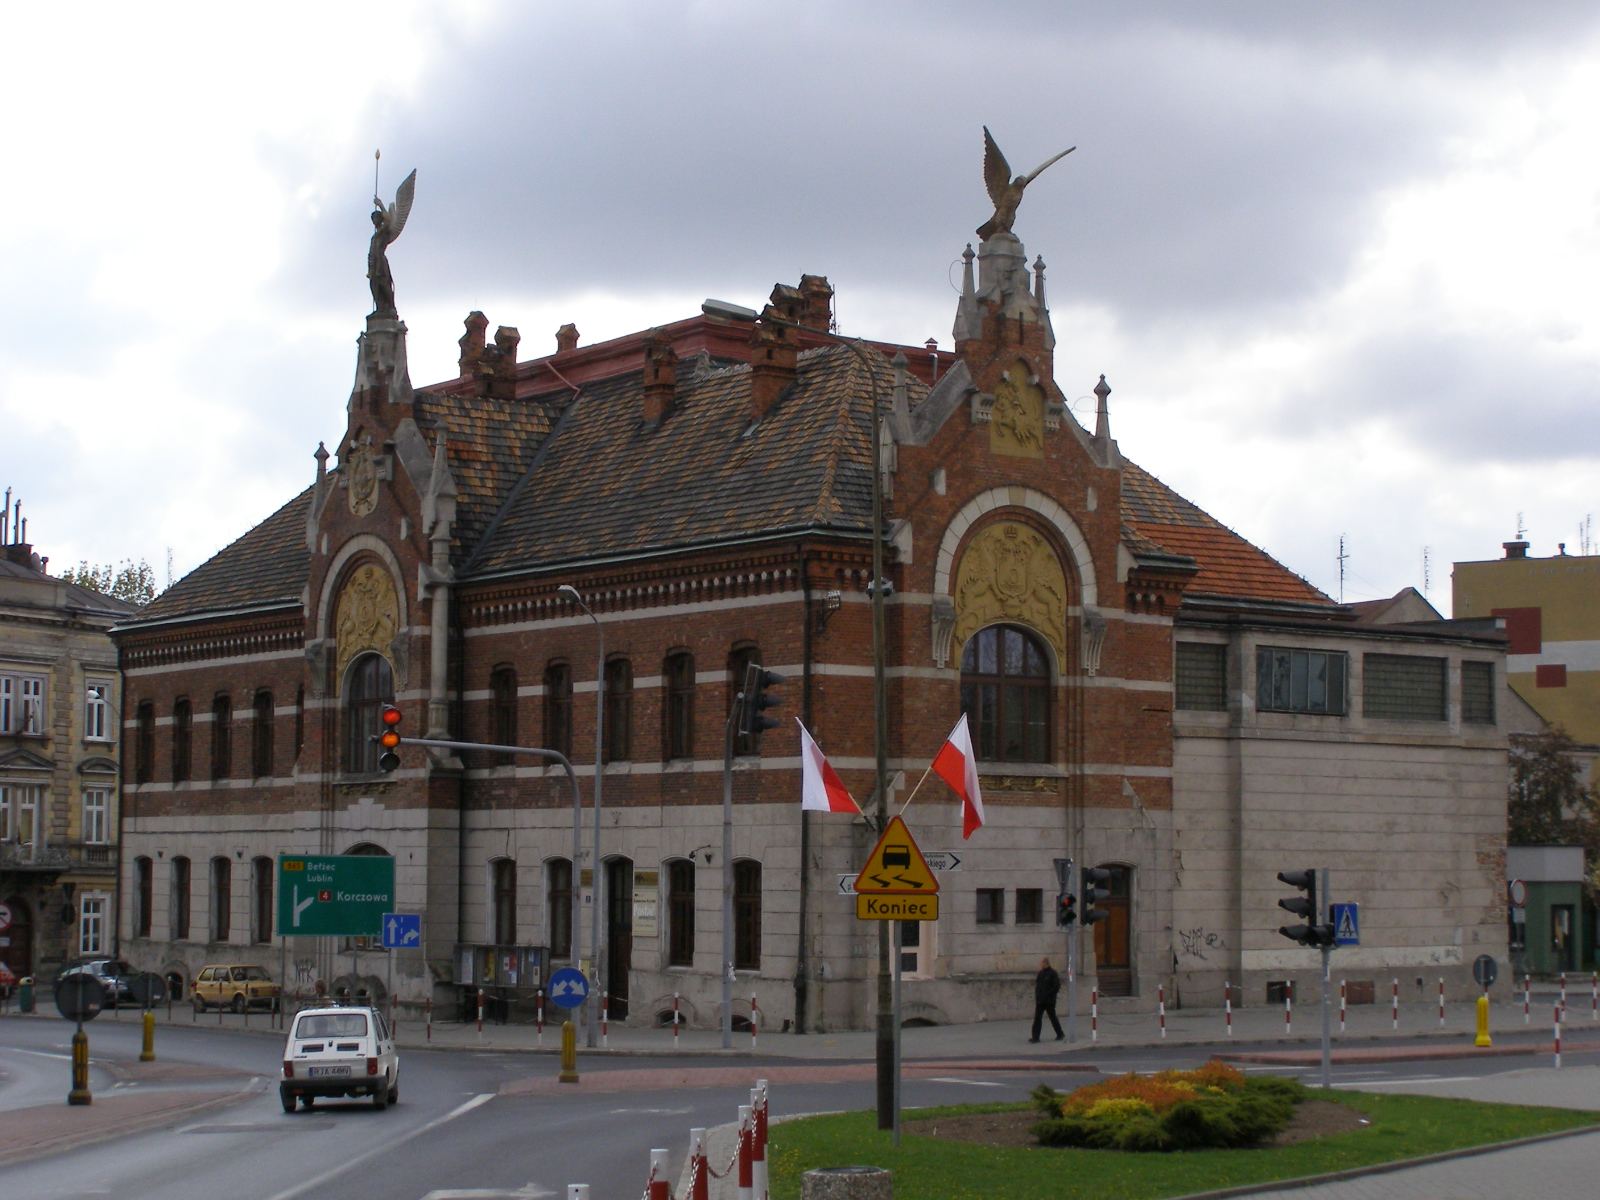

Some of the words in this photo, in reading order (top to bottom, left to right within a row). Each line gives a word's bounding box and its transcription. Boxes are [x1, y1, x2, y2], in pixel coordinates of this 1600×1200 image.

[307, 874, 333, 882] Lublin
[322, 892, 328, 900] 4
[337, 891, 388, 902] Korczowa
[867, 899, 928, 915] Koniec
